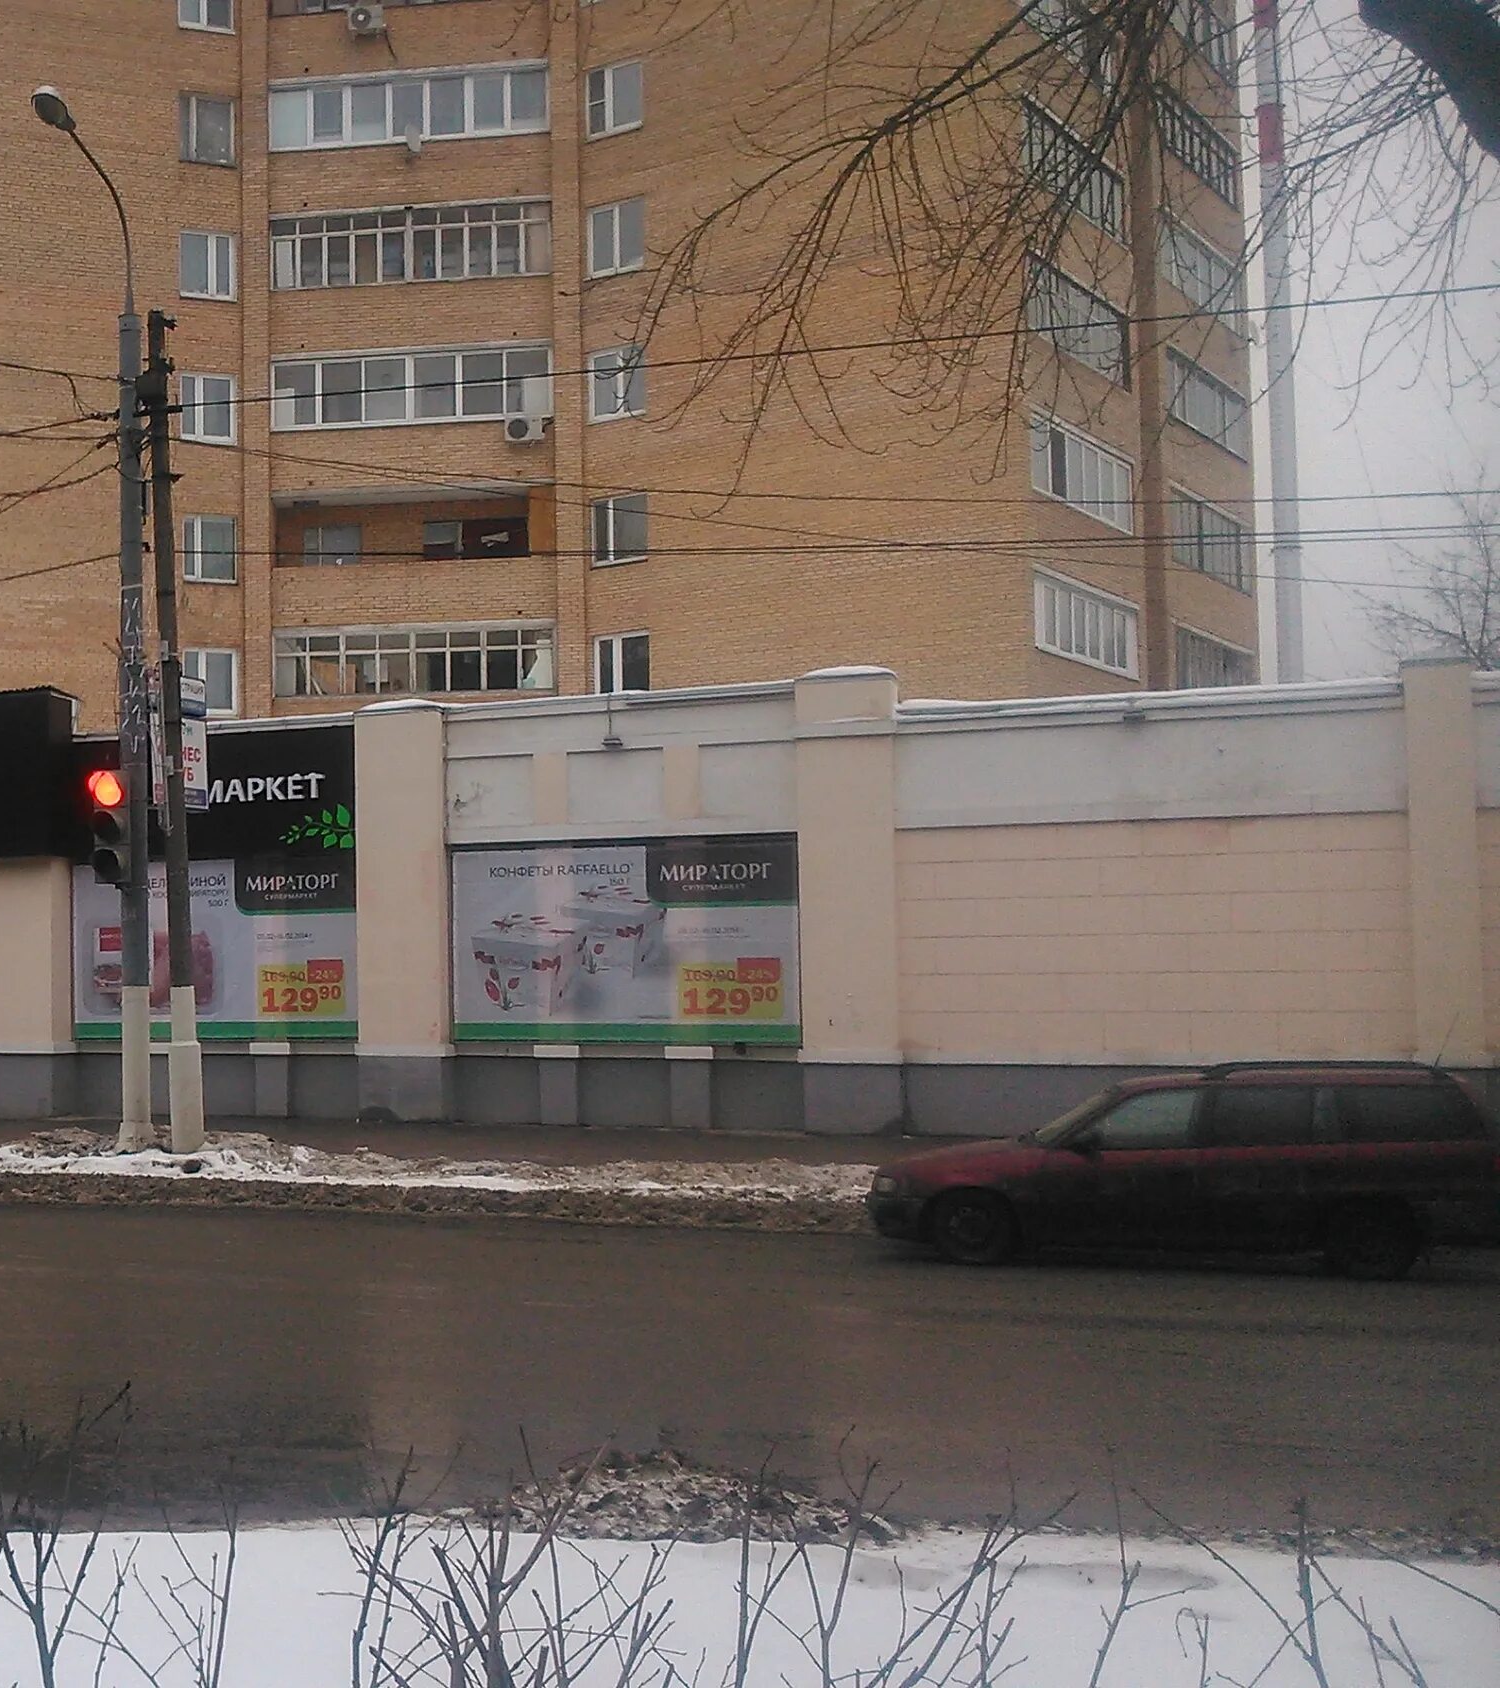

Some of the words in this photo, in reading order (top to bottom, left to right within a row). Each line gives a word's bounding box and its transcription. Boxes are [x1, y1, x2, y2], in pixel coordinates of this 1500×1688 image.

[209, 772, 326, 804] МАРКЕТ
[190, 873, 226, 887] ИНОЙ
[489, 866, 553, 879] КОНФЕТЫ
[659, 862, 772, 881] МИРАТОРГ
[245, 873, 339, 892] МИРАТОРГ
[263, 988, 319, 1012] 129
[683, 988, 751, 1015] 129
